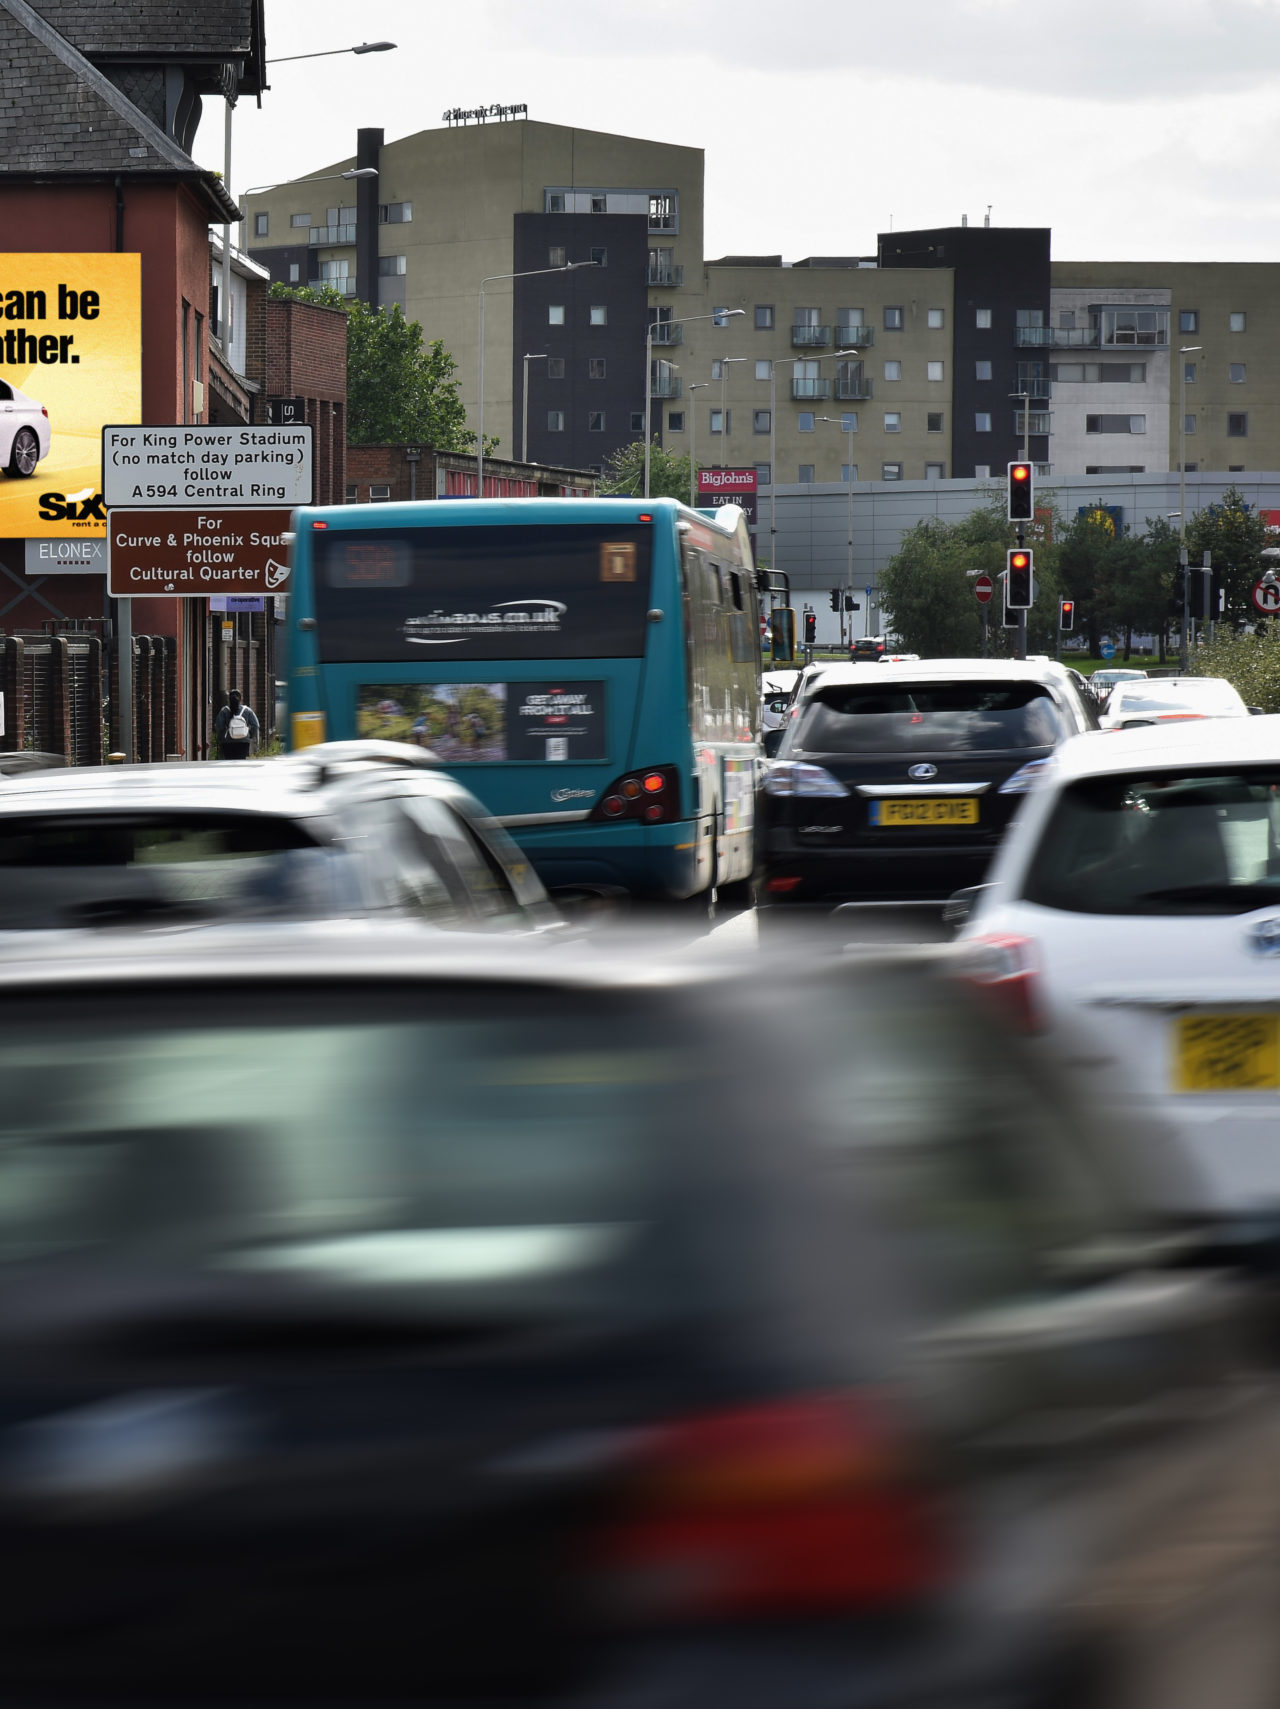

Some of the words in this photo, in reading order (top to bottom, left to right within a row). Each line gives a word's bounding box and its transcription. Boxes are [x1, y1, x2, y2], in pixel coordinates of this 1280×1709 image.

[58, 284, 100, 320] be
[111, 434, 136, 447] For
[143, 433, 177, 448] King
[184, 433, 233, 446] Power
[239, 432, 306, 446] Stadium
[146, 451, 195, 465] match
[201, 450, 229, 466] day
[183, 467, 233, 481] follow
[184, 484, 244, 497] Central
[250, 483, 286, 499] Ring
[712, 496, 730, 504] EAT
[732, 496, 743, 504] IN
[197, 516, 223, 530] For
[116, 533, 161, 547] Curve
[166, 533, 178, 547] &
[183, 532, 244, 547] Phoenix
[250, 532, 288, 548] Squa
[39, 542, 102, 559] ELONEX
[186, 549, 235, 563] follow
[129, 567, 194, 581] Cultural
[199, 566, 260, 581] Quarter
